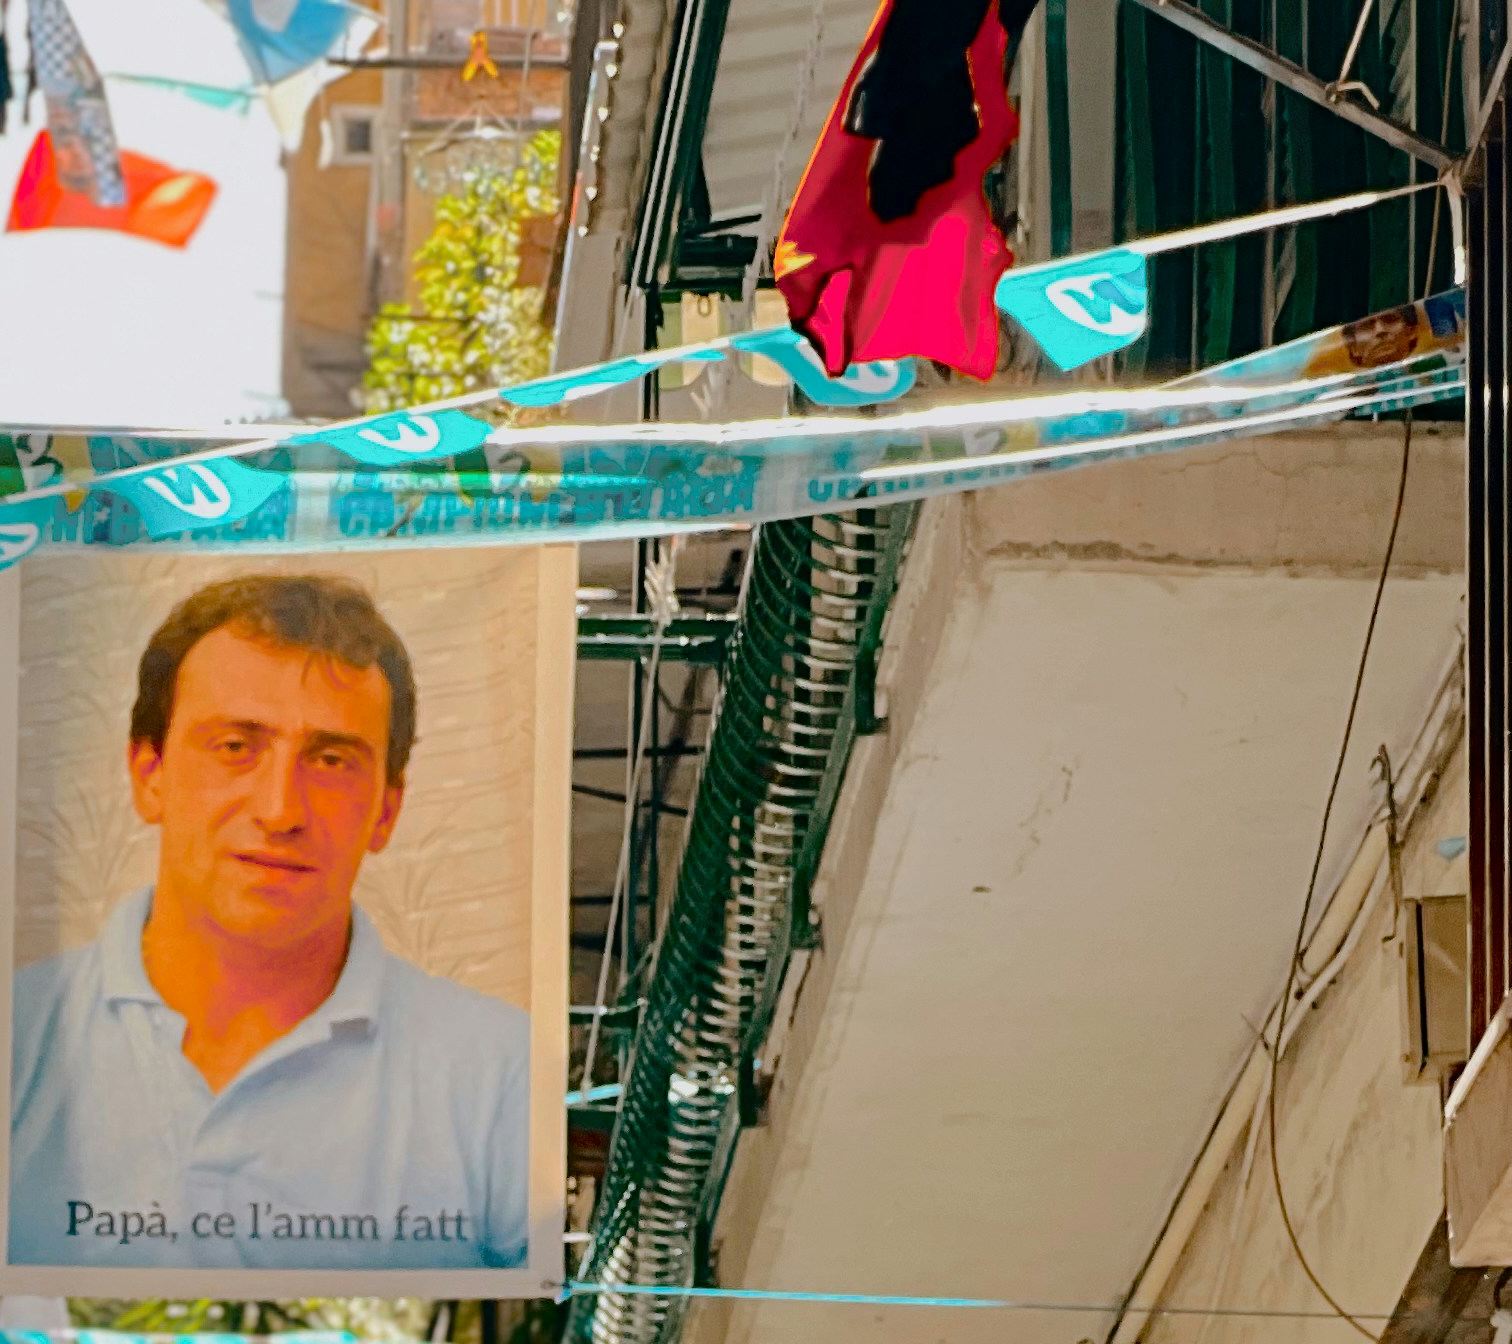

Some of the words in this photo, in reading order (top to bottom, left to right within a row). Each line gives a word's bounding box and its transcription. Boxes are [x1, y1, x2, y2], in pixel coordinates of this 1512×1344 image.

[65, 1200, 178, 1244] Papà,
[191, 1212, 236, 1239] ce
[249, 1202, 380, 1241] l'amm
[393, 1204, 470, 1242] fatt
